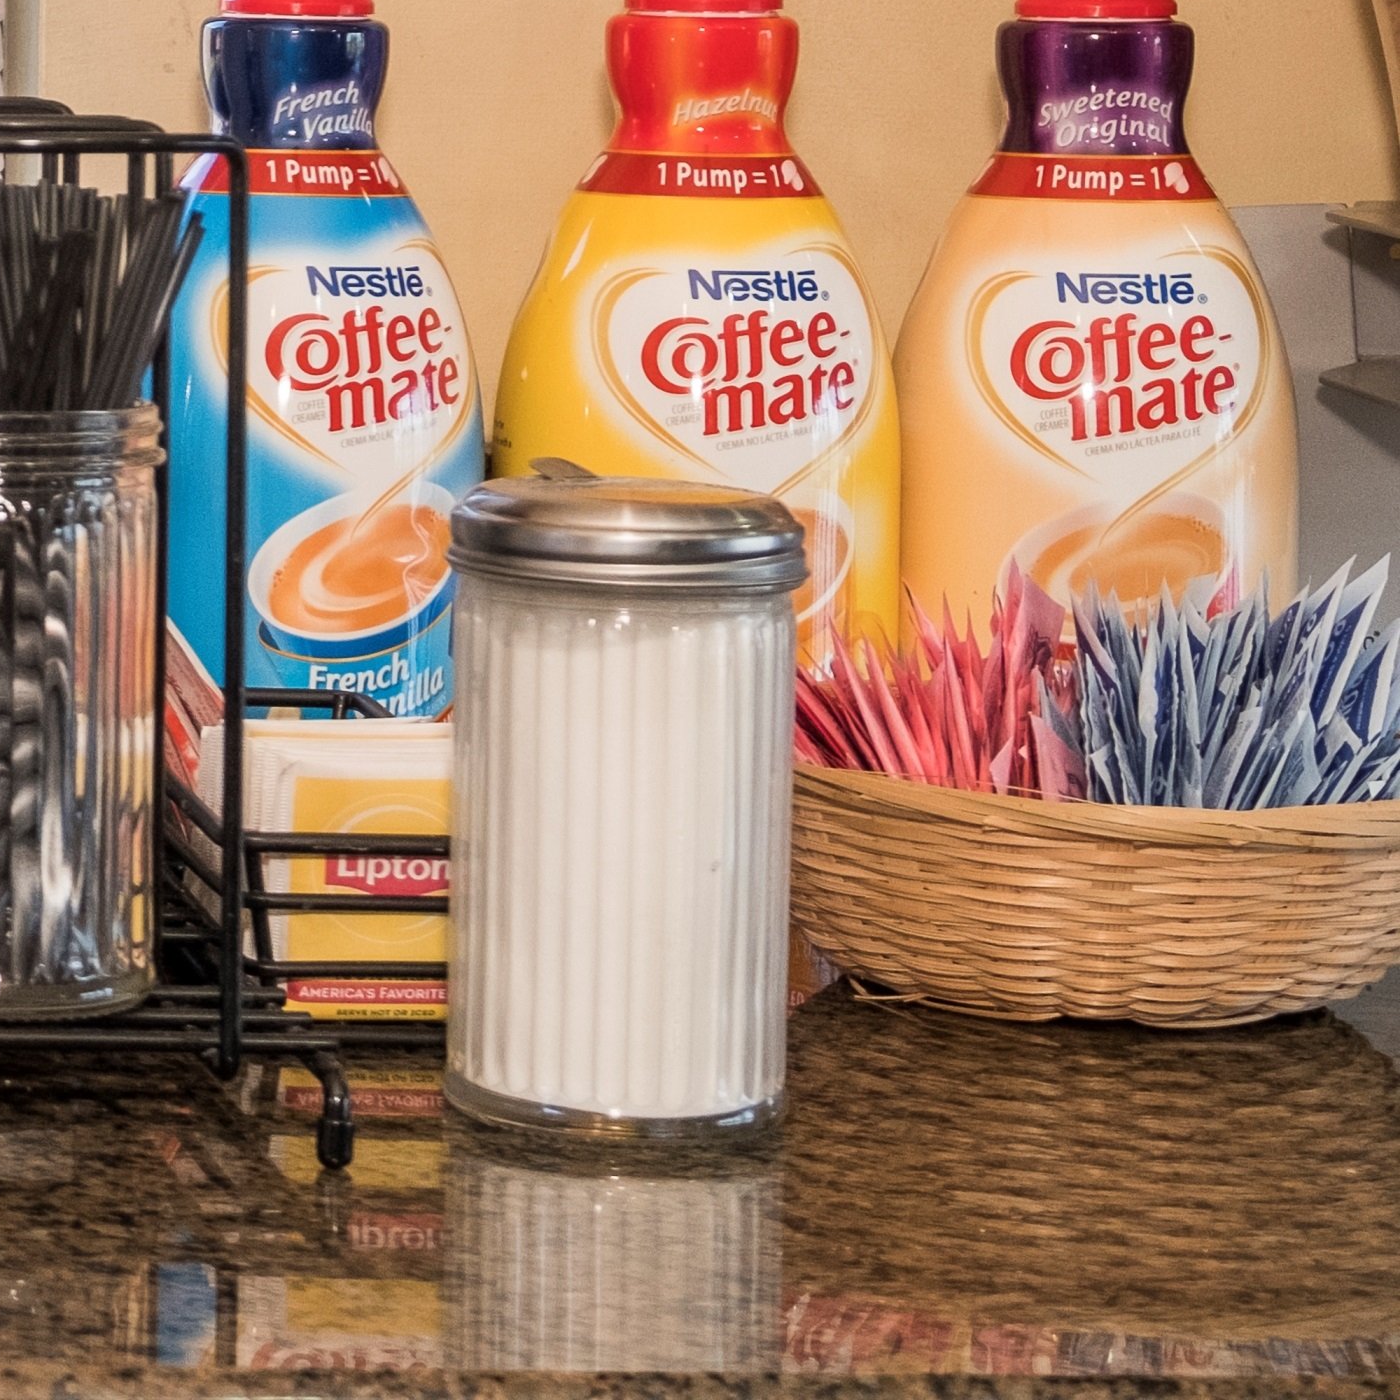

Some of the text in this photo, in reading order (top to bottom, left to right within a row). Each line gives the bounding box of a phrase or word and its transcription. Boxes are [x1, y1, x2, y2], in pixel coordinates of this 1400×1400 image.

[273, 80, 359, 124] French
[672, 88, 777, 126] Hazelnut
[1038, 88, 1173, 128] Sweetened
[303, 108, 373, 140] Vanilla
[1056, 114, 1170, 147] Original
[266, 160, 277, 183] 1
[285, 159, 354, 191] Pump
[657, 162, 667, 187] 1
[676, 162, 747, 194] Pump
[1035, 165, 1044, 188] 1
[1052, 164, 1124, 196] Pump
[1150, 166, 1160, 190] 1
[306, 265, 423, 297] Nestlé
[688, 269, 818, 301] Nestlé
[1056, 272, 1194, 305] Nestlé
[325, 356, 460, 432] mate
[702, 361, 855, 436] mate
[1068, 365, 1235, 442] mate
[1034, 419, 1069, 432] CREAMER
[1040, 406, 1068, 421] COFFEE
[1085, 444, 1113, 457] CREMA
[1115, 440, 1128, 451] NO
[309, 651, 408, 691] French
[336, 855, 449, 885] Lipton
[380, 986, 447, 999] FAVORITE
